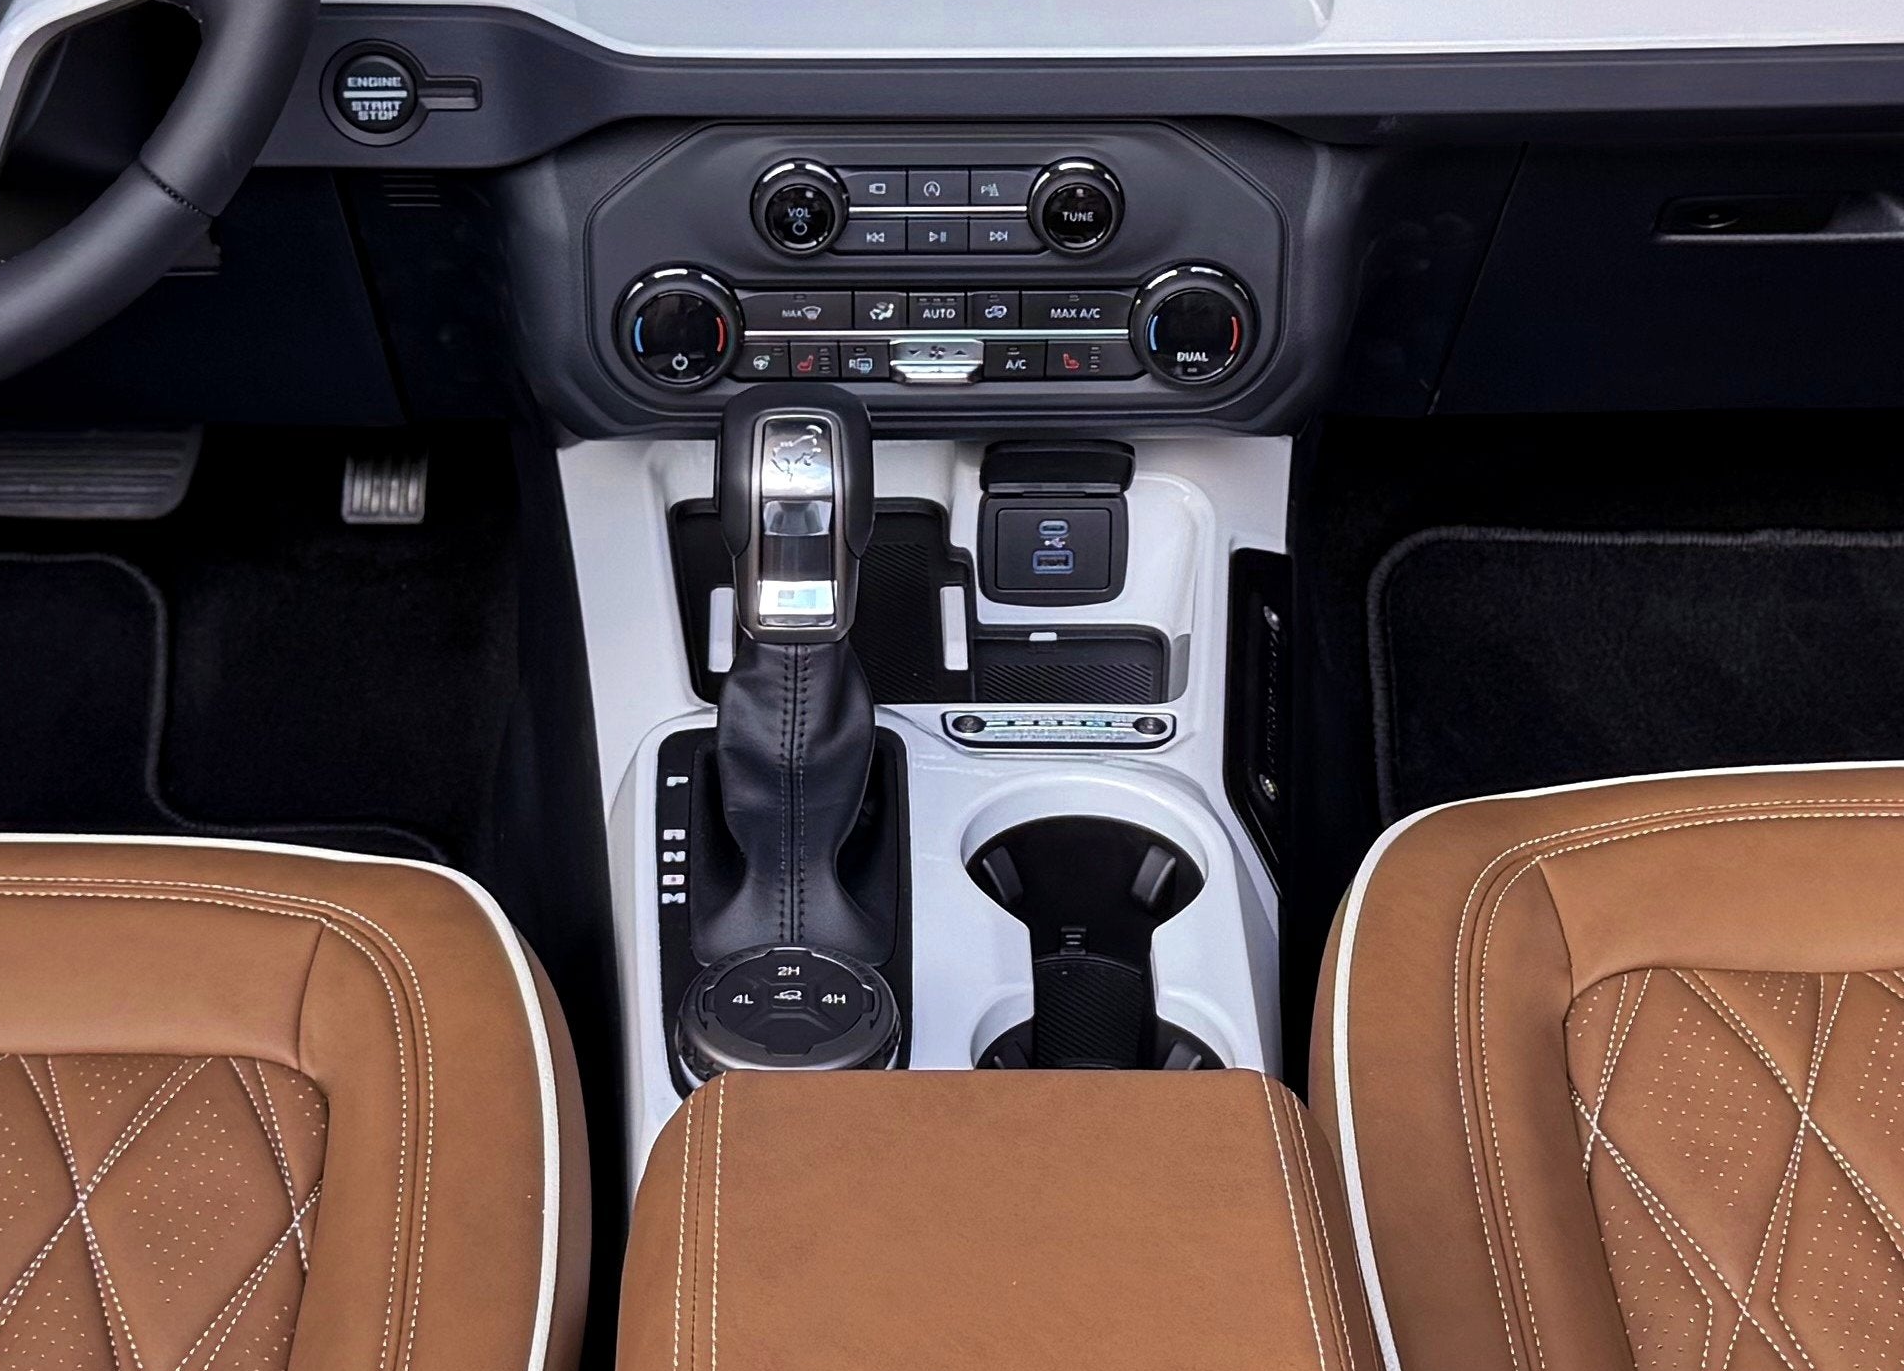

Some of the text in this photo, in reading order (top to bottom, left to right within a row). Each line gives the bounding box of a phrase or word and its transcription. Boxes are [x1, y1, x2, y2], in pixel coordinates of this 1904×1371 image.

[347, 76, 402, 88] ENGINE
[352, 101, 403, 112] START
[358, 111, 399, 121] STOP
[788, 207, 811, 219] VOL
[1062, 211, 1094, 223] TUNE
[782, 309, 802, 320] MAX
[923, 308, 956, 320] AUTO
[1050, 307, 1101, 321] MAX A/C
[1177, 351, 1209, 364] DUAL
[1005, 358, 1027, 372] A/C
[663, 851, 686, 863] N
[662, 892, 686, 904] M
[777, 966, 800, 976] 2H
[732, 994, 754, 1004] 4L
[821, 994, 846, 1004] 4H
